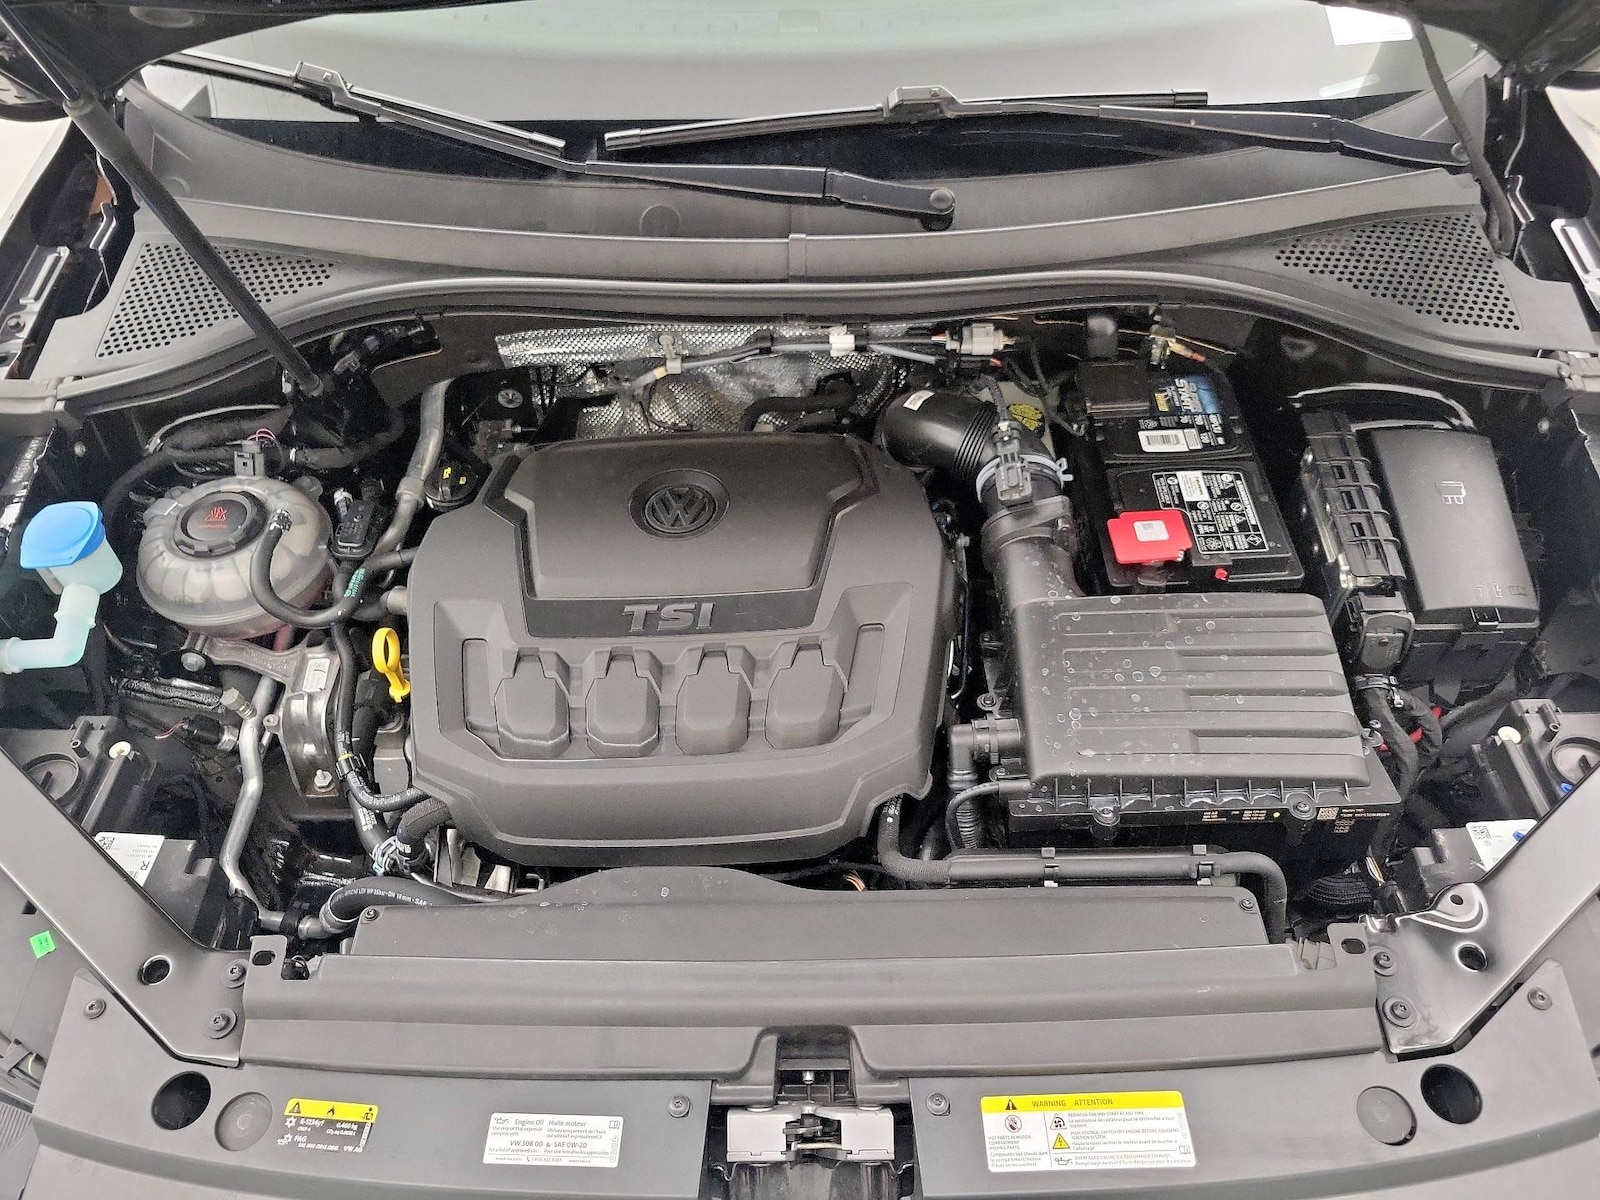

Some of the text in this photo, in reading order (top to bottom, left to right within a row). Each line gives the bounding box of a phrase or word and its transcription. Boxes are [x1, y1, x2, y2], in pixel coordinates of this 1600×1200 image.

[622, 602, 716, 632] TSI
[1032, 1098, 1113, 1108] WARNING ATTENTION
[515, 1118, 535, 1126] Engine
